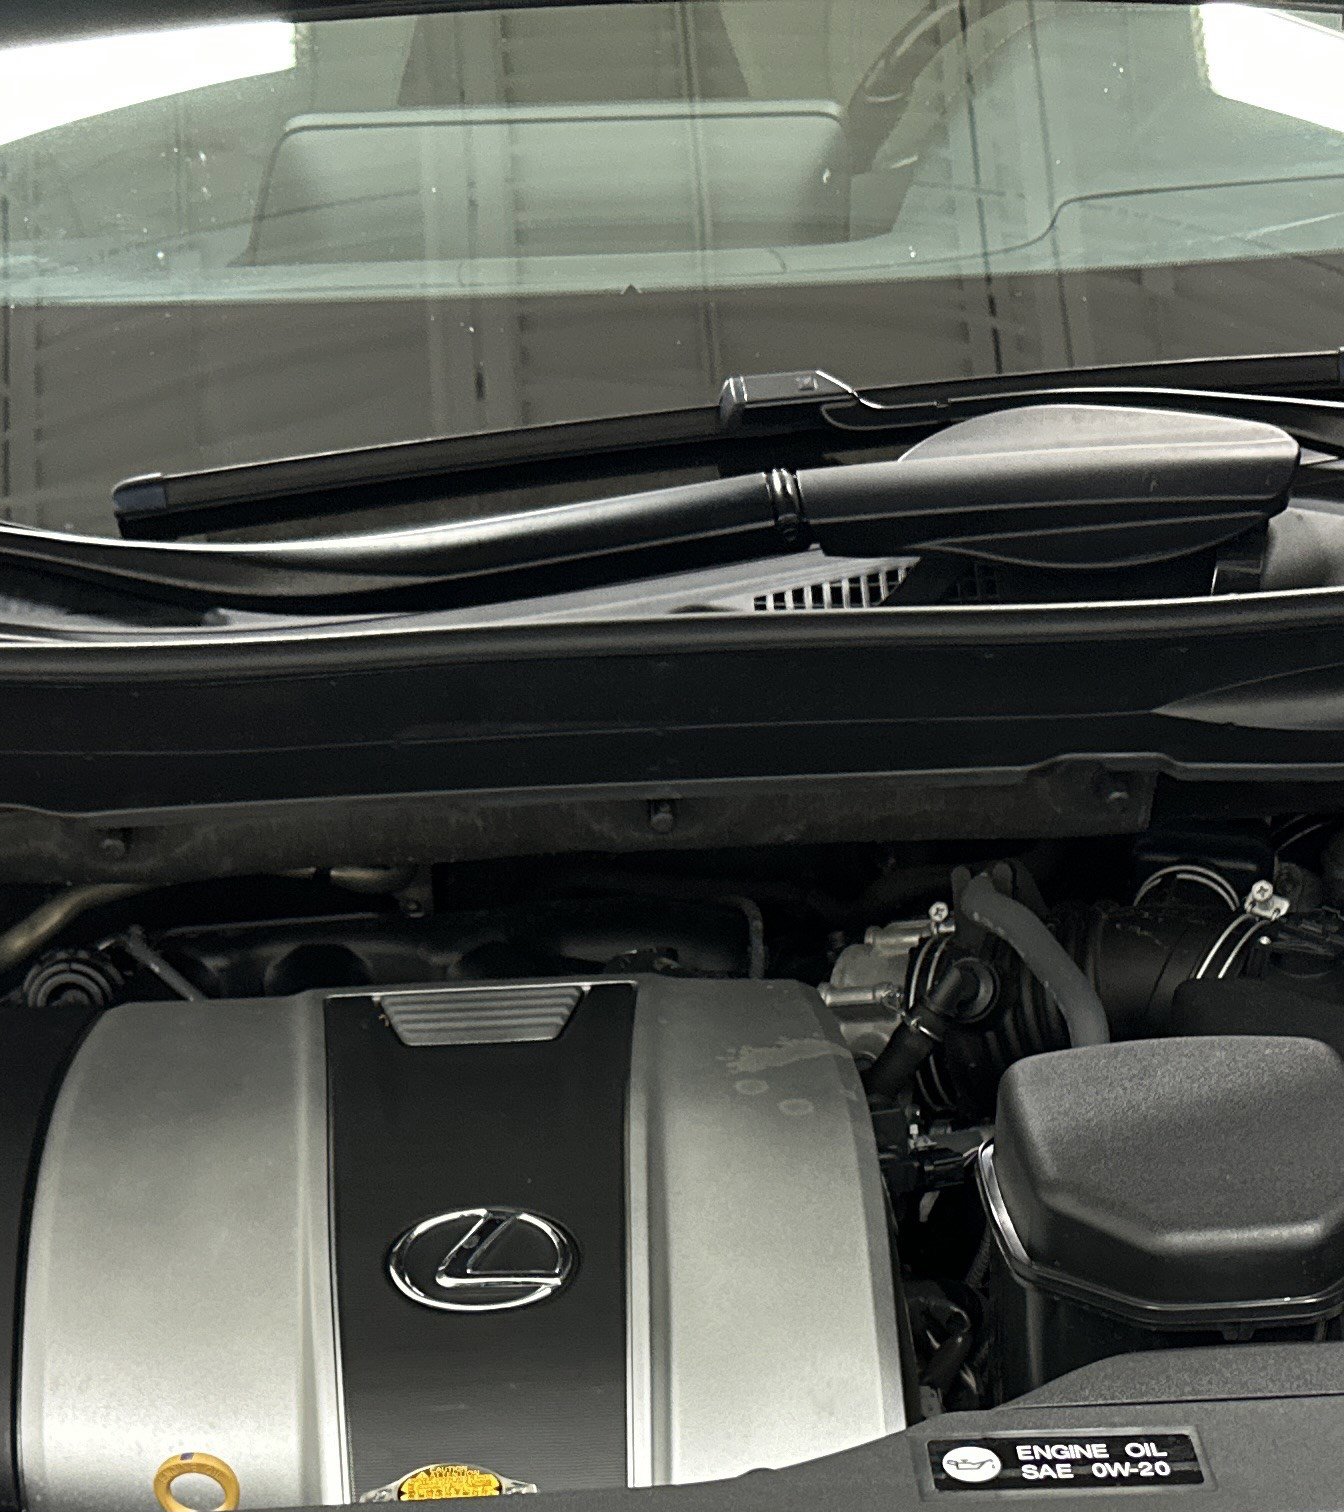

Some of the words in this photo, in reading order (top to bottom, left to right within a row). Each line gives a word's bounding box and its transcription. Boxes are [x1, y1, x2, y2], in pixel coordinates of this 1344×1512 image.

[1016, 1443, 1110, 1461] ENGINE
[1124, 1442, 1168, 1458] OIL
[1022, 1463, 1074, 1480] SAE
[1091, 1461, 1171, 1478] 0W-20
